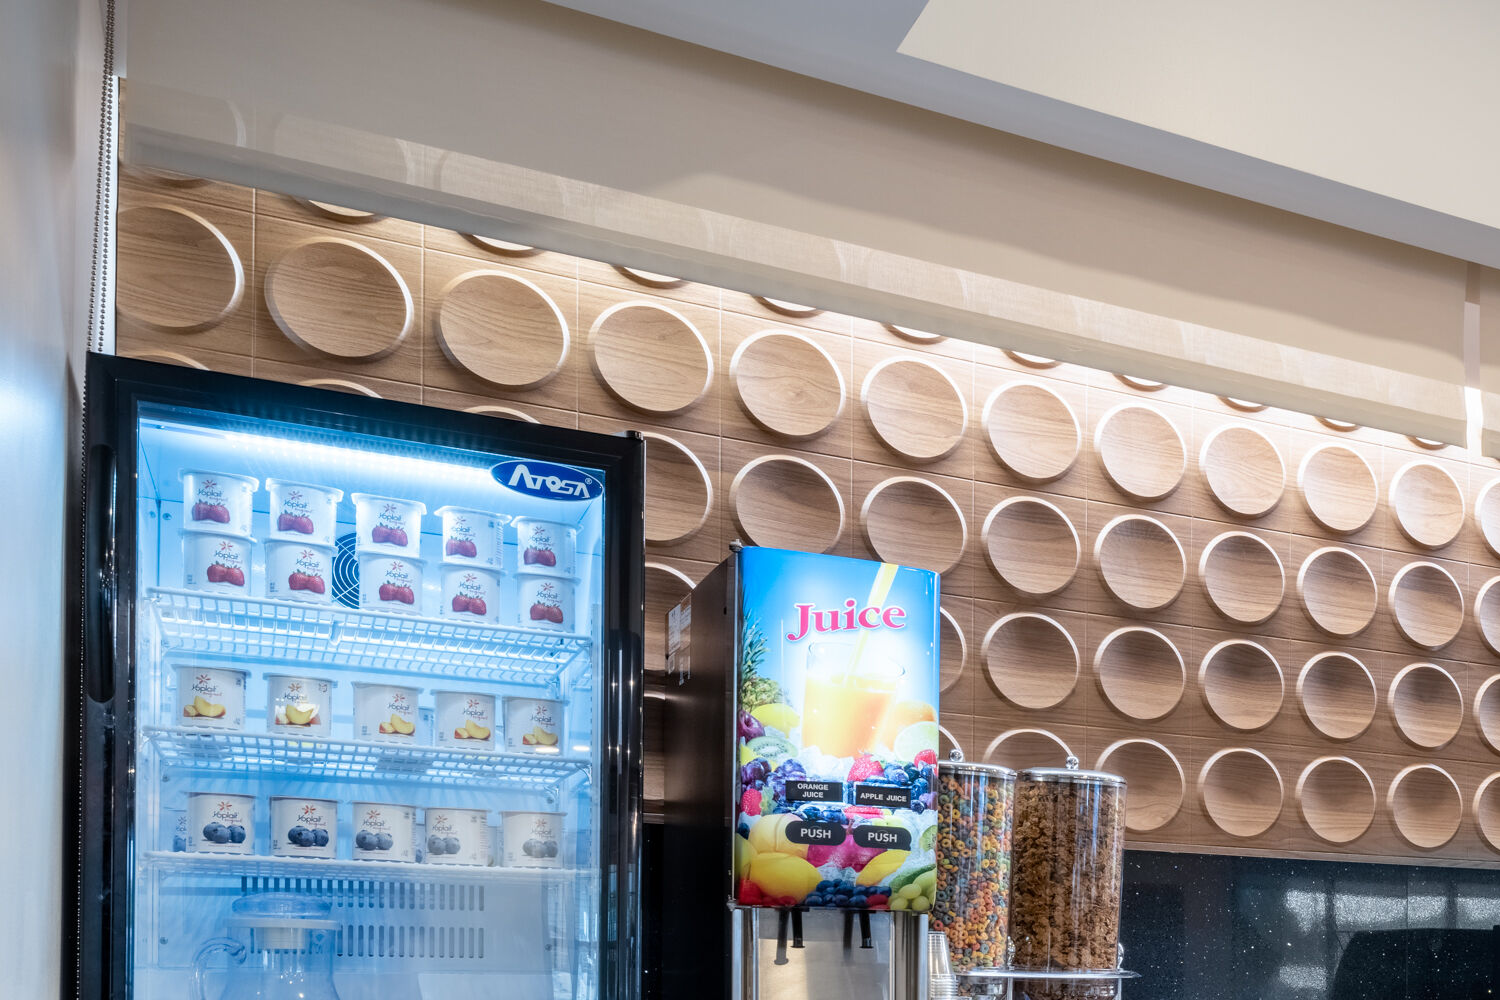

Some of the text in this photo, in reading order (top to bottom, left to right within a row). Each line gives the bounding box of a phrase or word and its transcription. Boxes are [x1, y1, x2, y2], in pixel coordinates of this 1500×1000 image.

[451, 525, 471, 534] oplait
[214, 550, 239, 561] Yoplait
[296, 558, 319, 569] Yoplait
[787, 600, 905, 641] Juice
[462, 707, 485, 718] Yoplait
[797, 783, 829, 791] ORANGE
[802, 791, 824, 799] JUICE
[860, 792, 907, 803] APPLE JUICE
[213, 810, 239, 821] Yoplait
[297, 815, 322, 825] Yoplait
[801, 828, 832, 839] PUSH
[868, 832, 897, 843] PUSH
